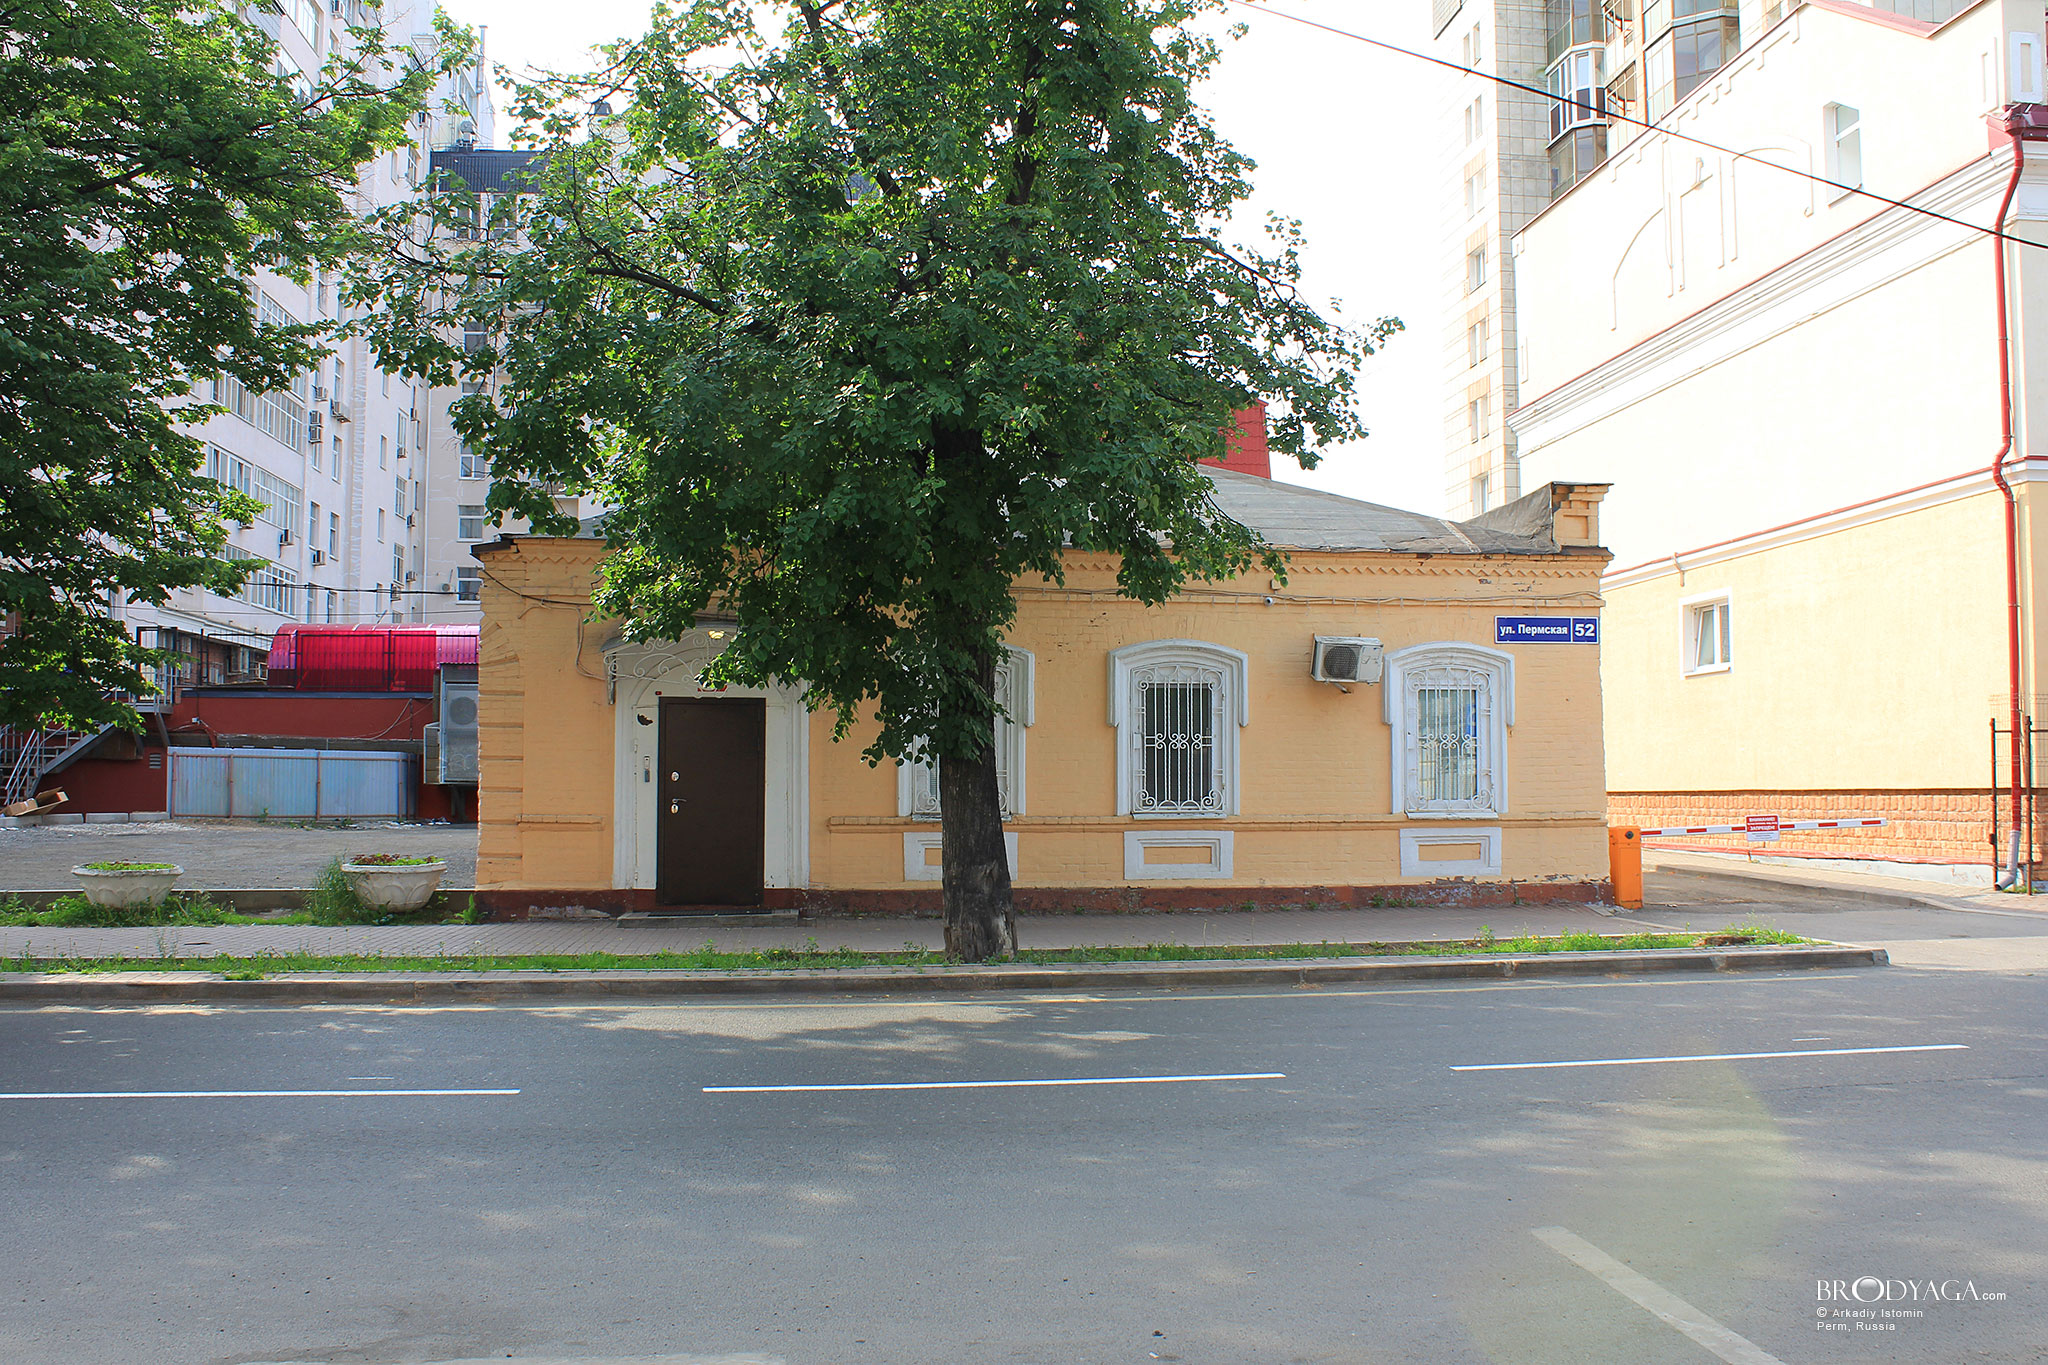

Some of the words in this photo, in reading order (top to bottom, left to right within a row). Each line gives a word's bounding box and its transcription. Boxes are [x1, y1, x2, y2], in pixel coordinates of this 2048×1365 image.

[1500, 626, 1515, 636] ул.
[1518, 624, 1568, 636] Пермская
[1574, 623, 1595, 636] 52
